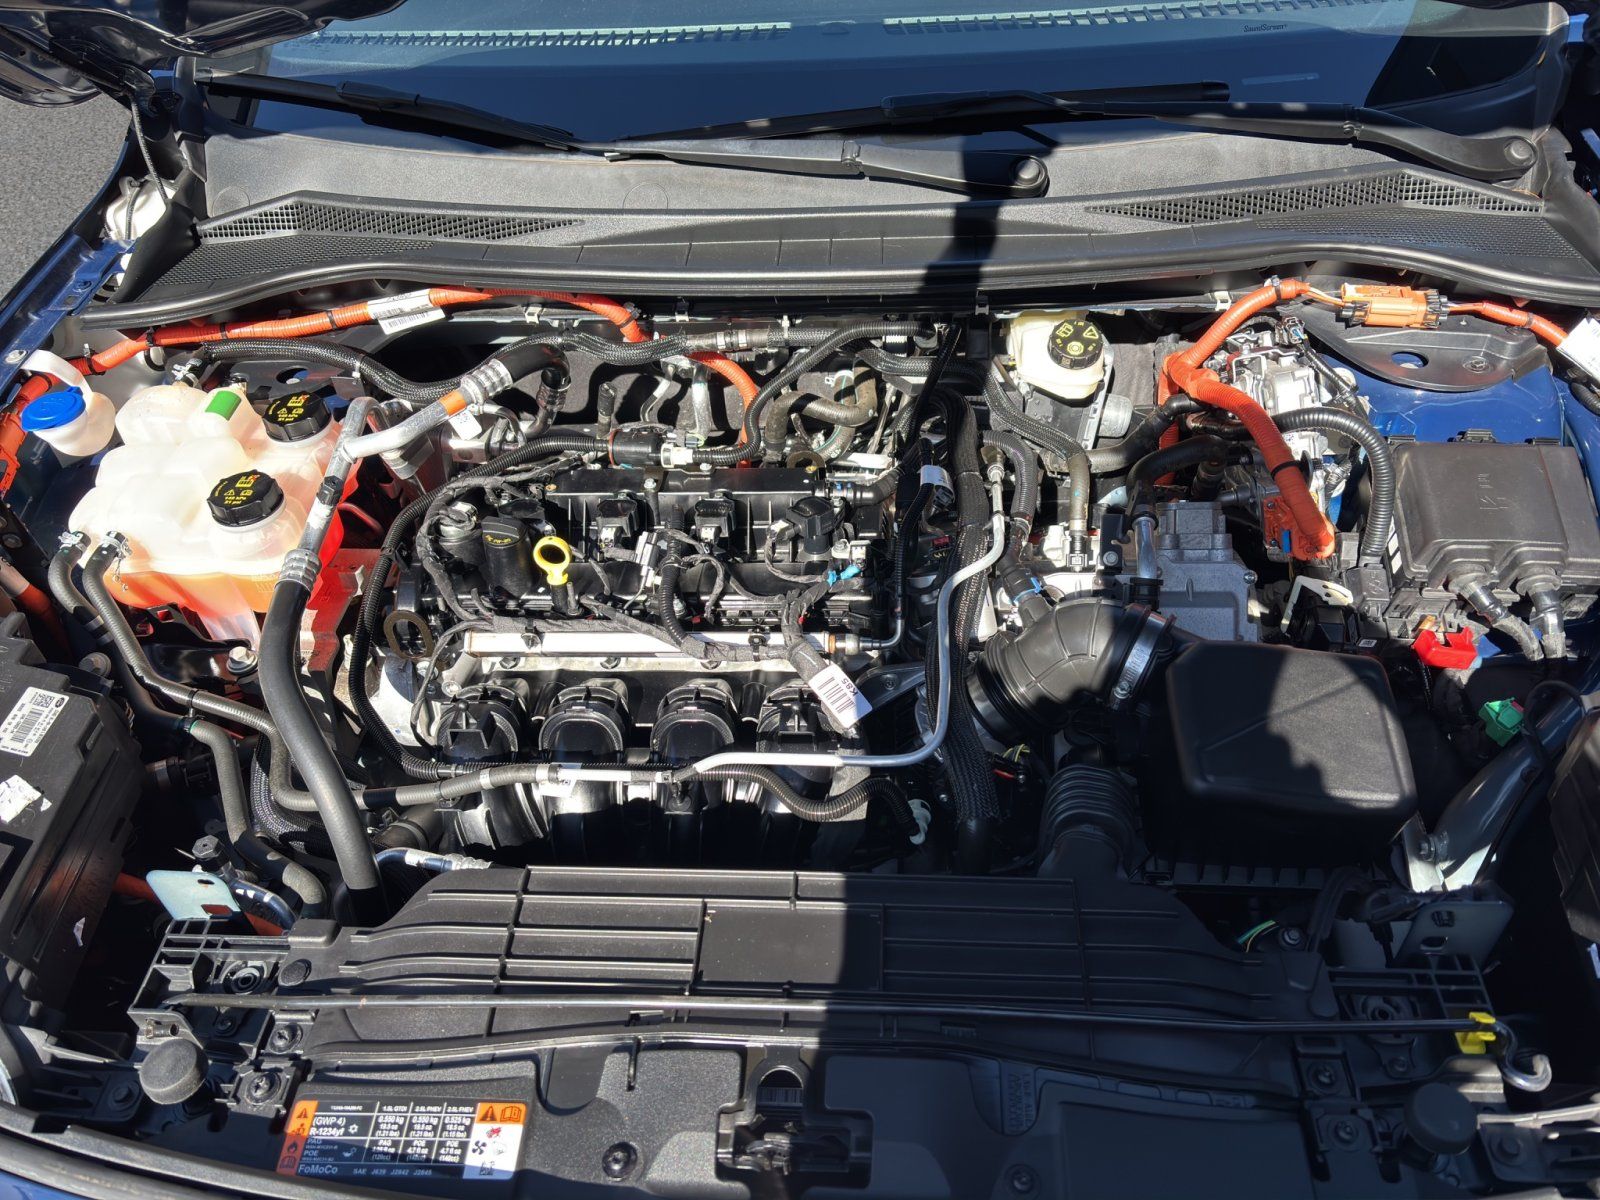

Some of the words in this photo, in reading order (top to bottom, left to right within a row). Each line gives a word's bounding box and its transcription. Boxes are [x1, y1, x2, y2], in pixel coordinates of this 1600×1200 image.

[312, 1116, 336, 1126] (GWP
[309, 1127, 345, 1136] R-1234yf
[298, 1164, 338, 1174] FoMoCo
